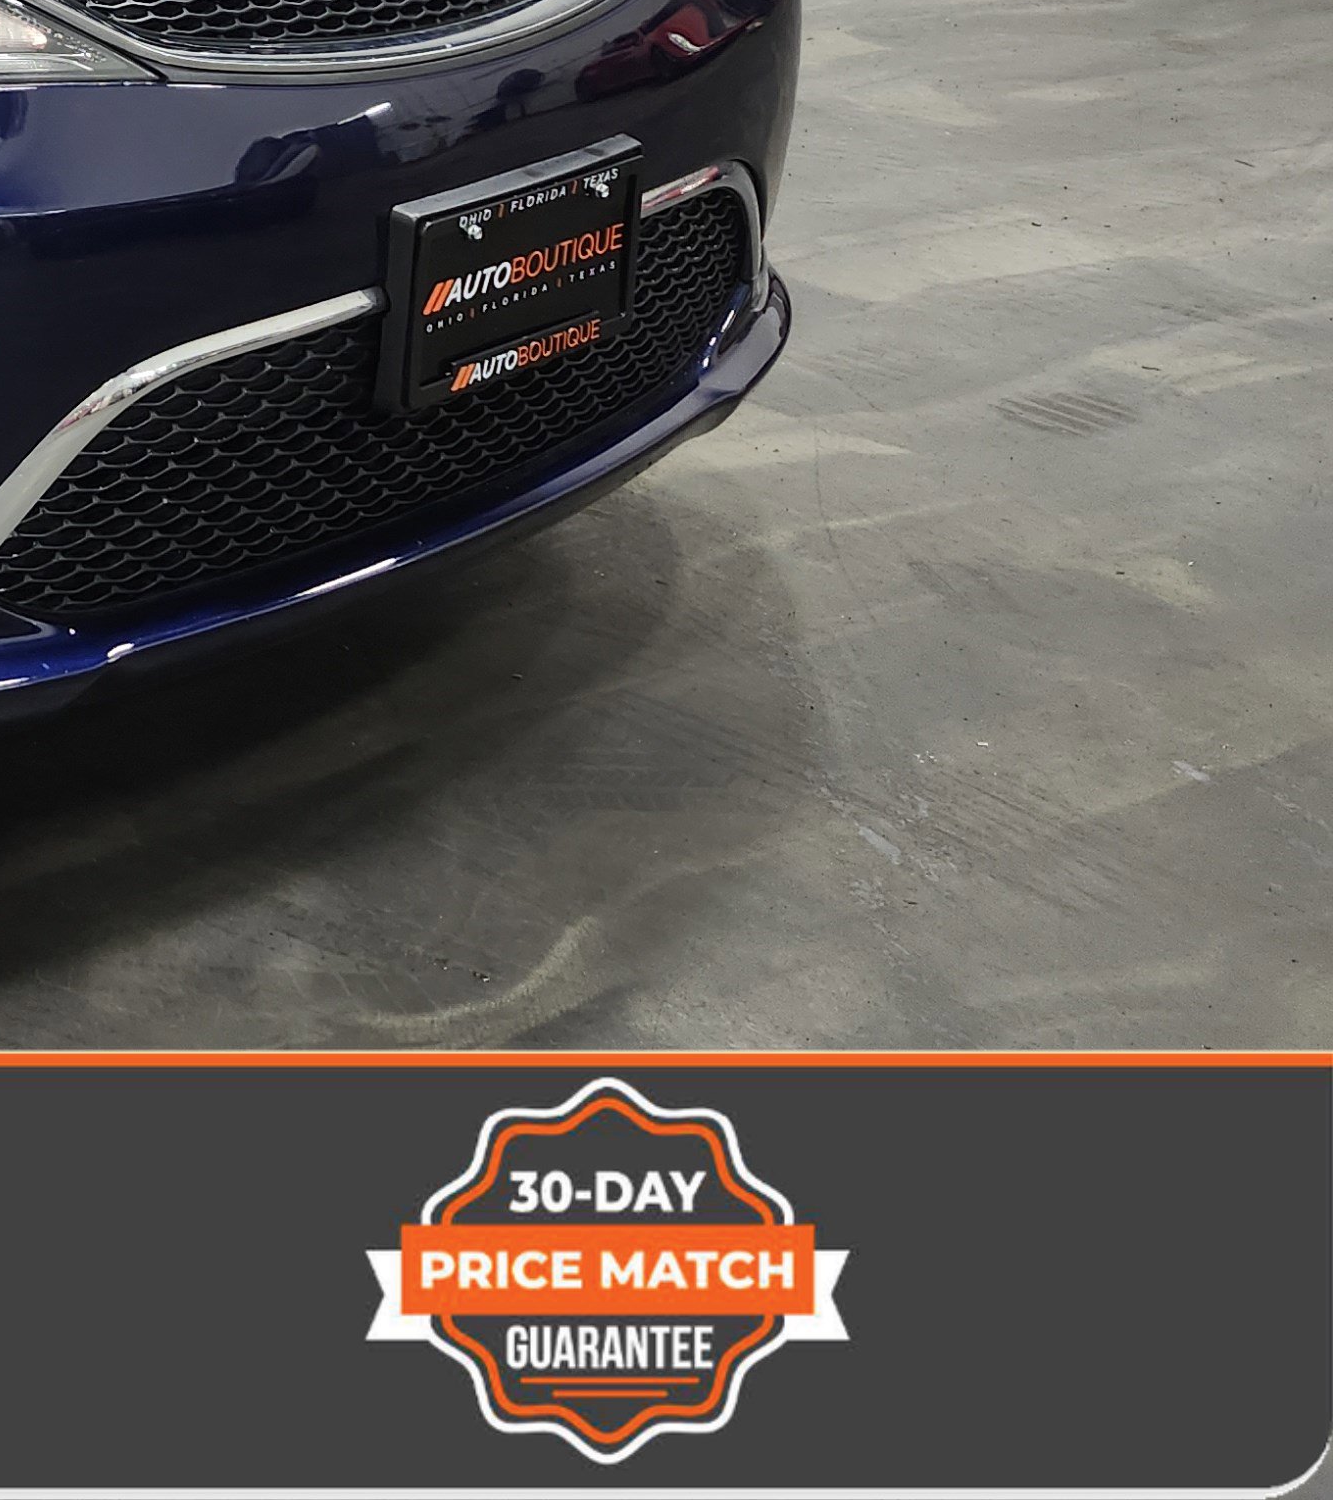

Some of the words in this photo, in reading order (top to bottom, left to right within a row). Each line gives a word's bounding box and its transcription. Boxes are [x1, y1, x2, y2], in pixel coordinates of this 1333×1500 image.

[458, 208, 493, 229] OHIO
[509, 186, 567, 214] FLORIDA
[583, 168, 620, 190] TEXAS
[426, 313, 464, 334] OHIO
[482, 284, 549, 313] FLORIDA
[569, 260, 617, 284] TEXAS
[444, 223, 625, 307] AUTOBOUTIQUE
[468, 318, 602, 385] AUTOBOUTIQUE
